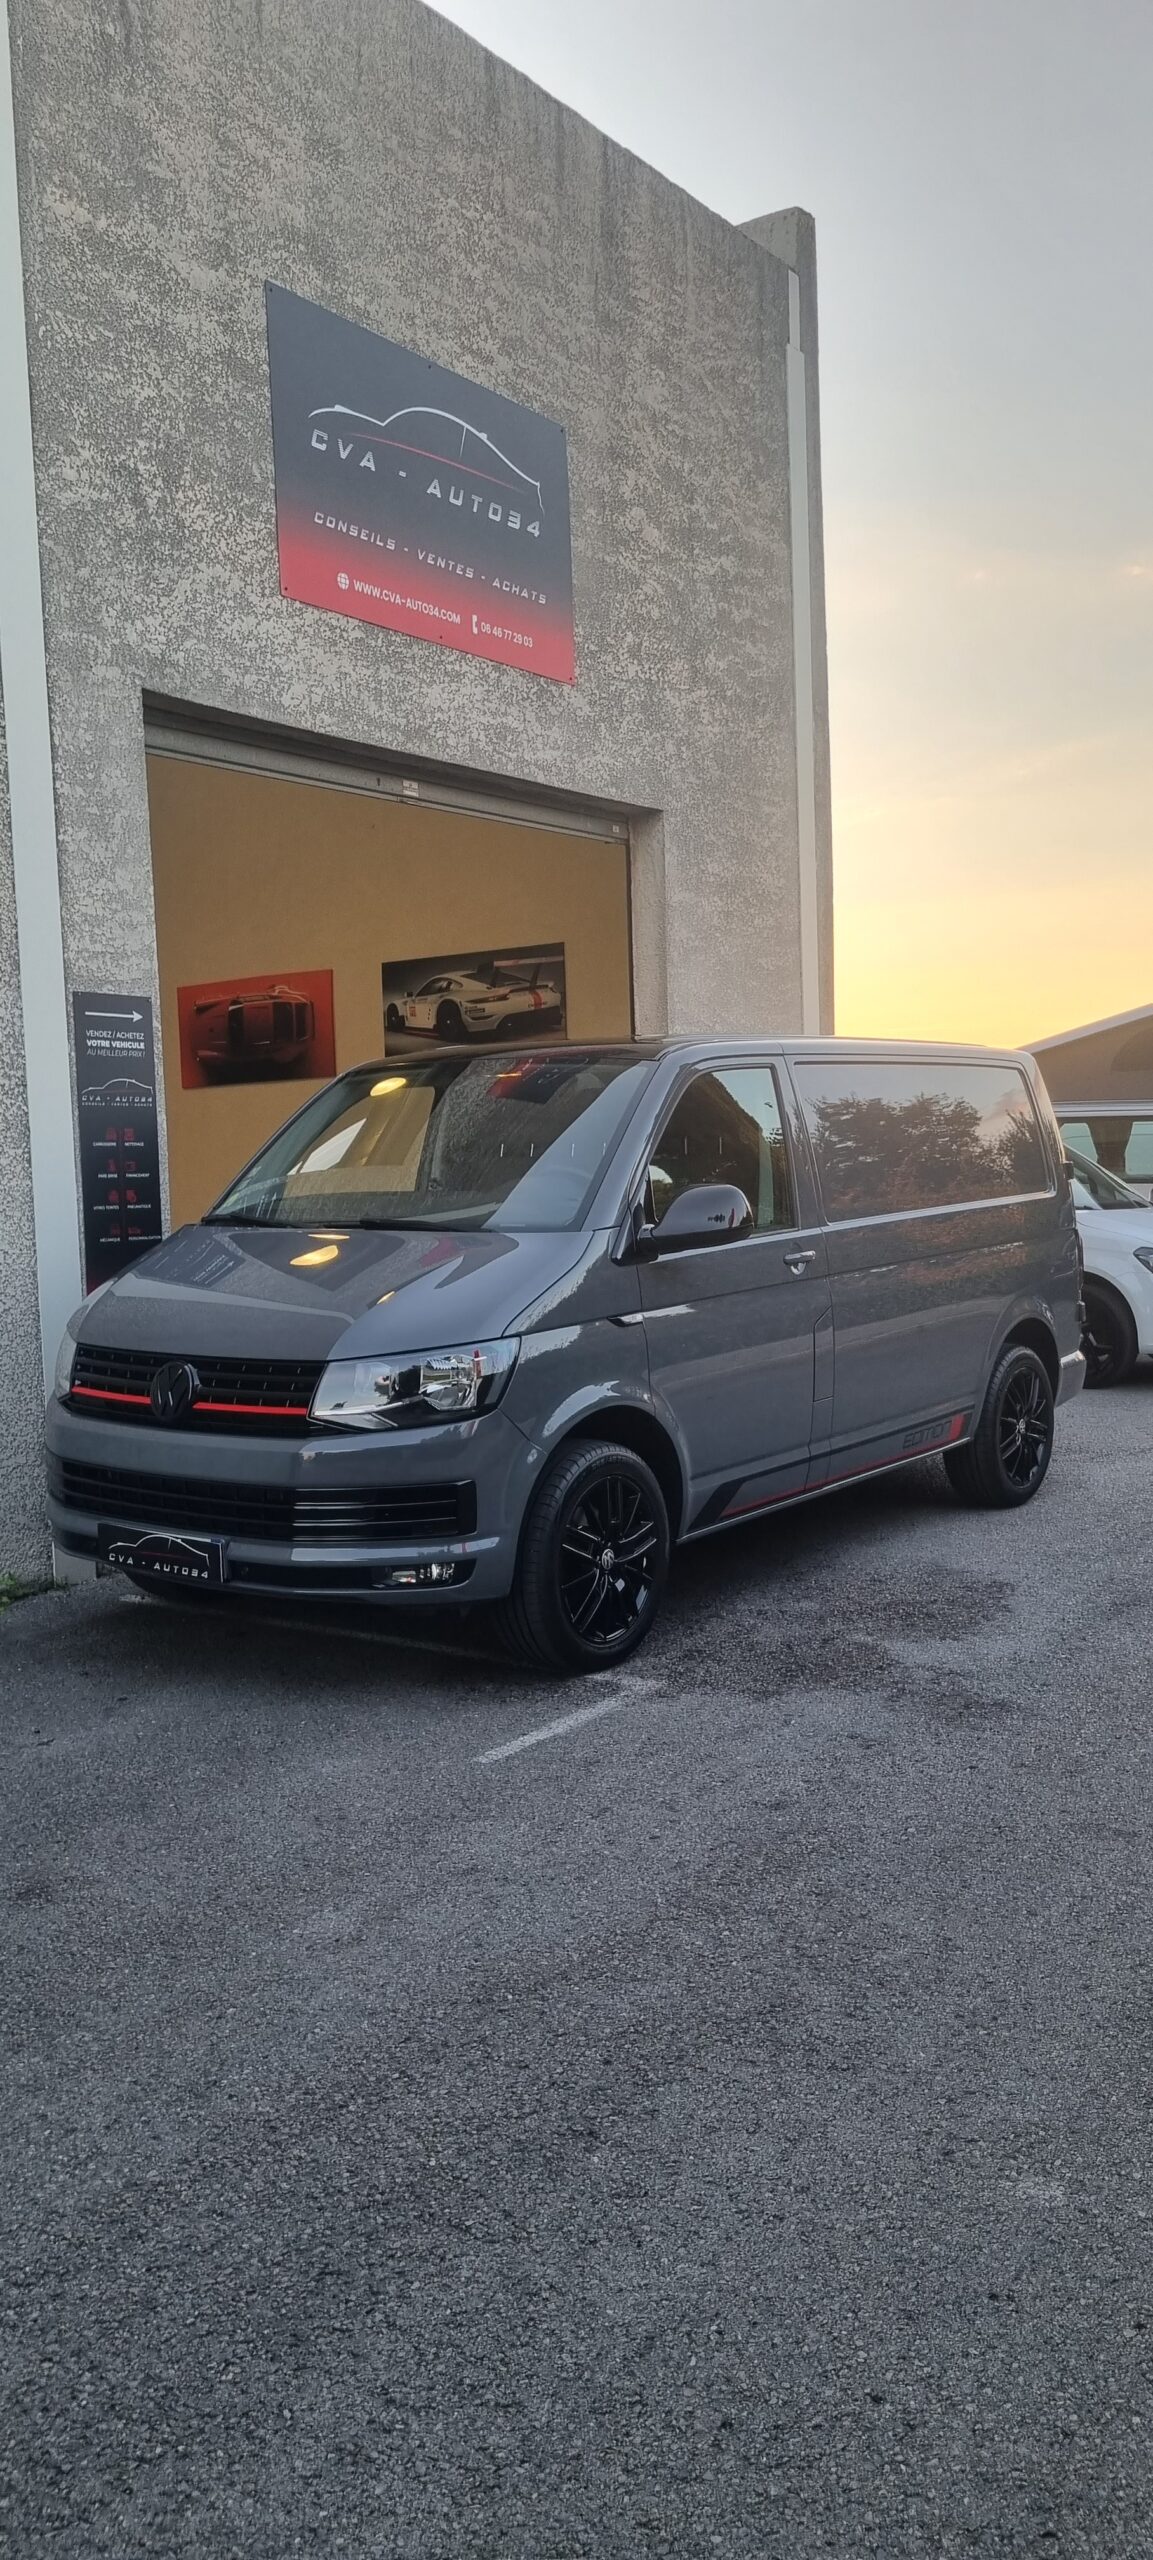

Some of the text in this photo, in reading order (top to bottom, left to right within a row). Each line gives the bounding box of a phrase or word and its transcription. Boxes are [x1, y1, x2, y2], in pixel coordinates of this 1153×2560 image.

[311, 429, 376, 471] CVA
[426, 478, 540, 538] AUTO34
[314, 511, 396, 550] CONSEILS
[417, 549, 474, 579] VENTES
[492, 577, 547, 605] ACHATS
[354, 579, 461, 624] WWW.CVA-AUTO34.COM
[503, 629, 512, 641] 77
[513, 632, 523, 644] 29
[523, 635, 533, 648] 03
[86, 1029, 112, 1038] VENDEZ
[116, 1031, 144, 1040] ACHETEZ
[86, 1039, 145, 1049] VOTRE VEHICULE
[87, 1048, 97, 1056] AU
[97, 1048, 128, 1057] MEILLEUR
[109, 1553, 133, 1564] CVA
[154, 1562, 208, 1578] AUTO34
